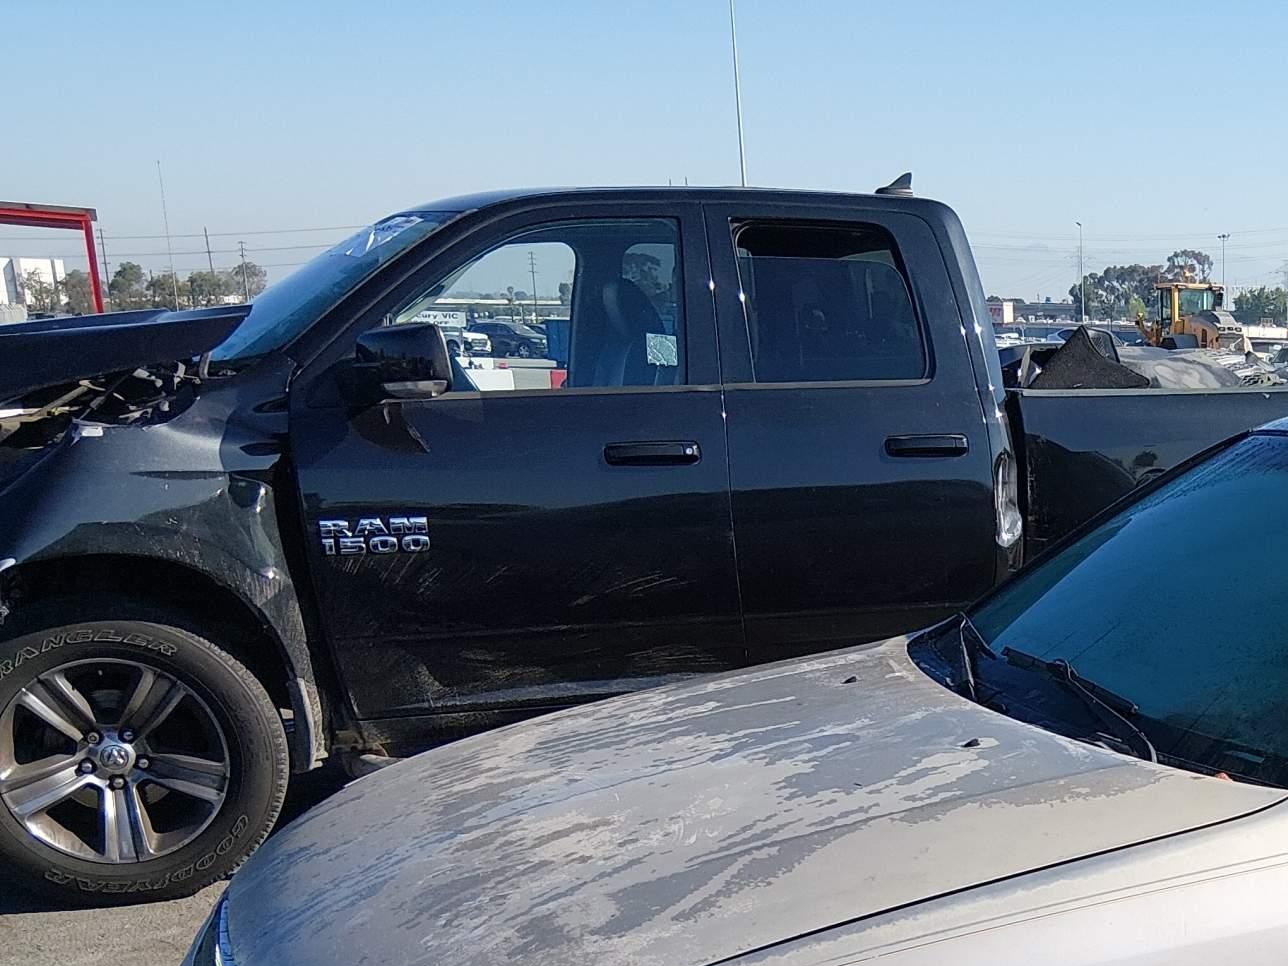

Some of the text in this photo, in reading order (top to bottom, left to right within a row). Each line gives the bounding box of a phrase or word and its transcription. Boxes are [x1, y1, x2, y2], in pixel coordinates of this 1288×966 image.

[318, 516, 429, 537] RAM
[321, 535, 431, 556] 1500
[0, 629, 178, 681] RANGLER
[44, 814, 250, 894] GOODYEAR
